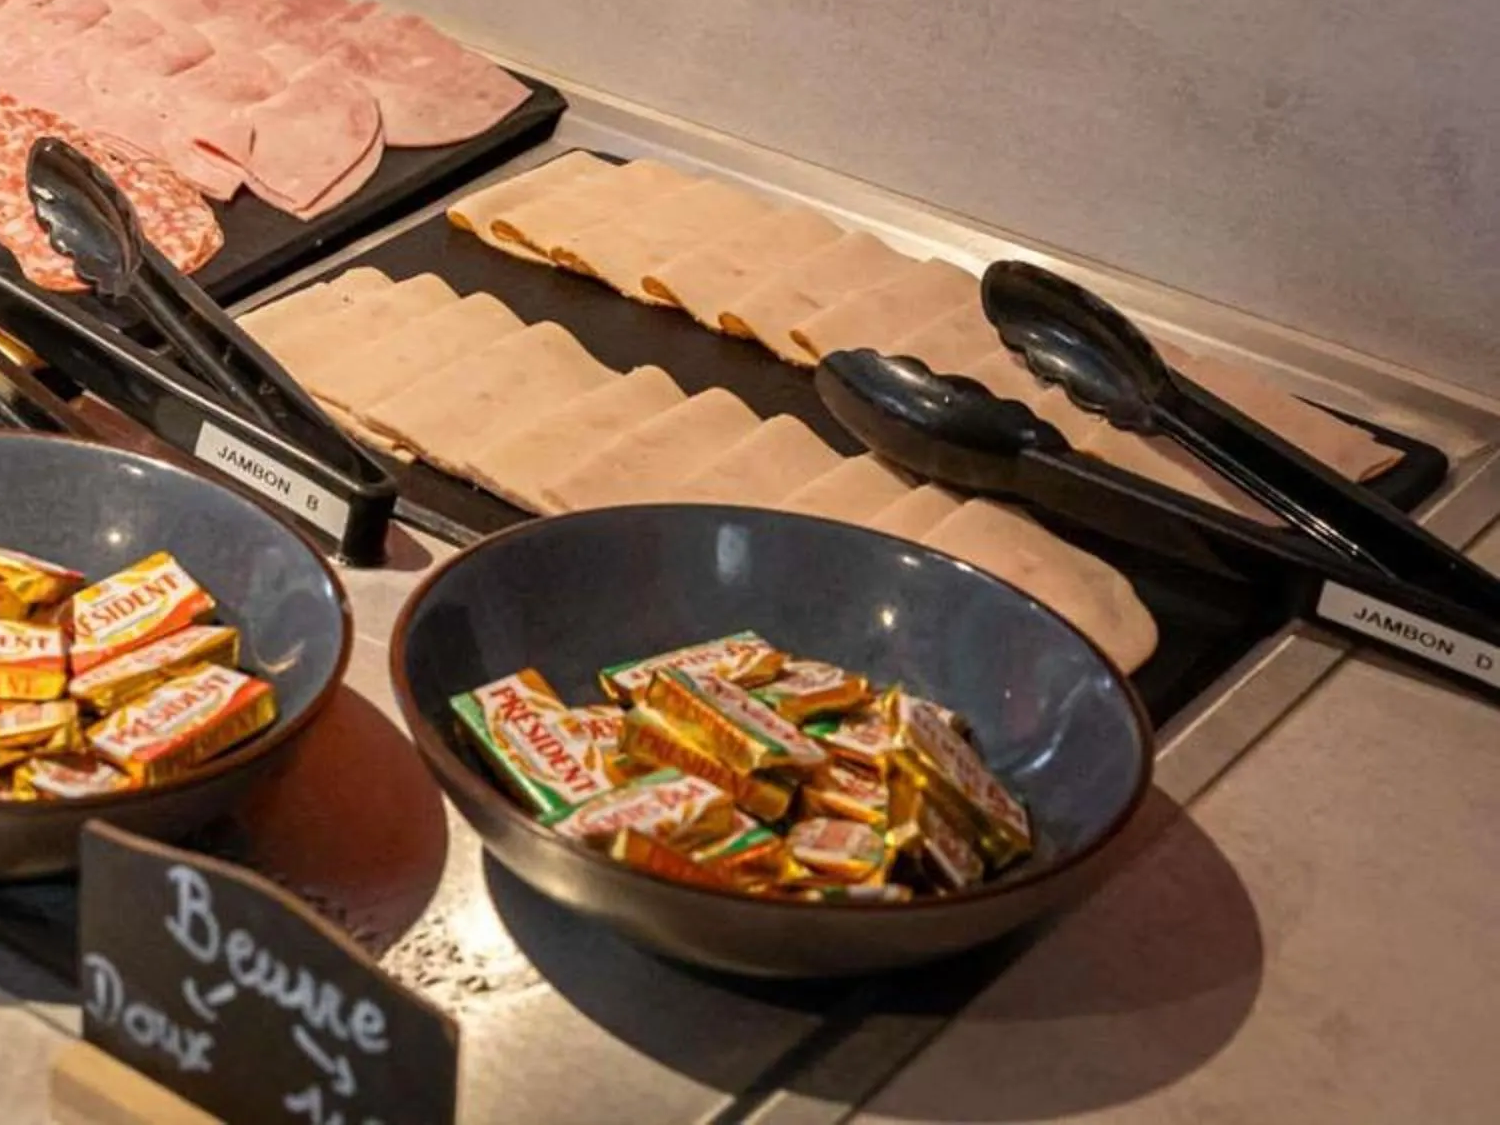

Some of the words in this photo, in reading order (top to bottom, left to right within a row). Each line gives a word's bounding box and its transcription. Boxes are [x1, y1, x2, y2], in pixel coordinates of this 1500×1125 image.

[216, 446, 292, 496] JAMBON
[306, 494, 319, 511] B
[1352, 606, 1456, 656] JAMBON
[1476, 653, 1493, 671] D
[83, 952, 215, 1072] Doux
